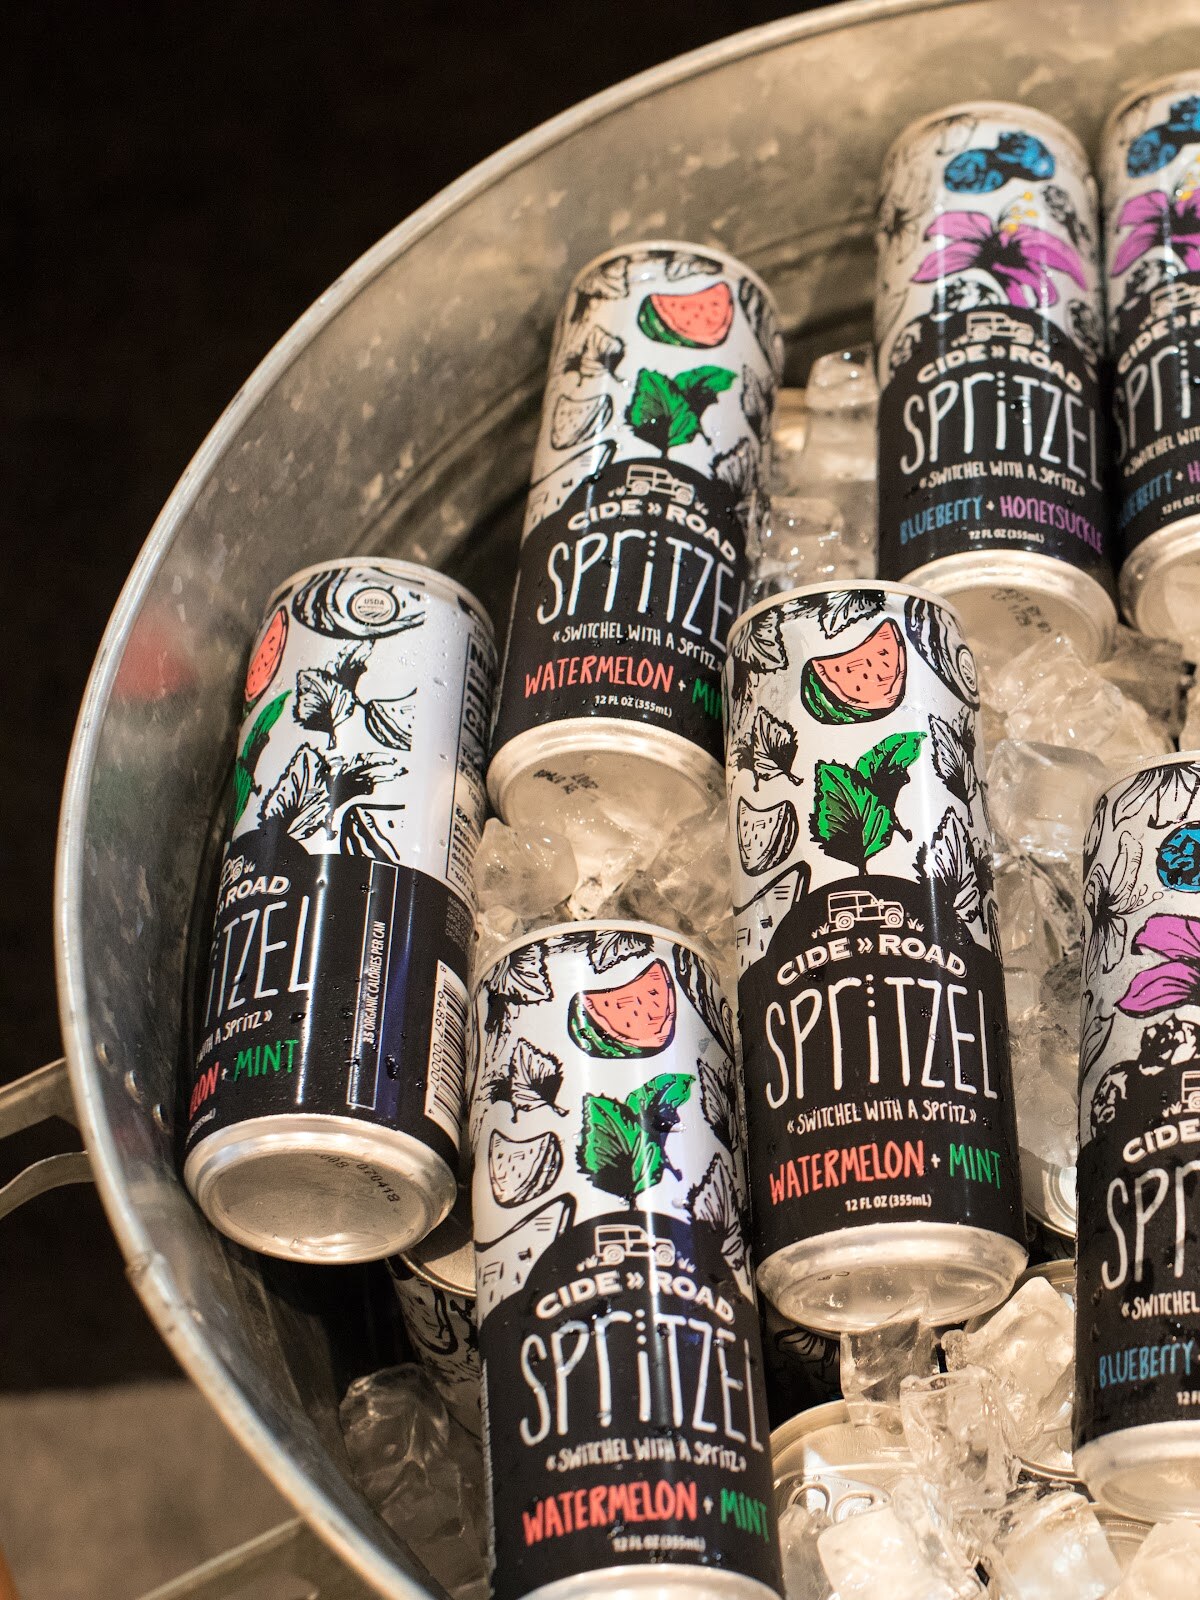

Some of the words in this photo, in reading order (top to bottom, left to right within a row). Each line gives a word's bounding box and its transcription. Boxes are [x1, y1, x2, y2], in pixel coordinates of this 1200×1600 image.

[1118, 320, 1169, 374] CIDE
[917, 344, 988, 383] CIDE
[1010, 345, 1083, 393] ROAD
[928, 461, 986, 488] SWITCHEL
[990, 460, 1024, 479] WITH
[1027, 463, 1037, 479] A
[1162, 504, 1173, 515] 12
[1174, 500, 1183, 510] FL
[1183, 495, 1196, 506] OZ
[567, 499, 643, 531] CIDE
[666, 504, 737, 562] ROAD
[968, 530, 980, 540] 12
[981, 530, 992, 539] FL
[993, 530, 1007, 538] OZ
[364, 598, 385, 606] USDA
[561, 621, 623, 643] SWITCHEL
[628, 624, 662, 643] WITH
[666, 632, 675, 650] A
[524, 655, 674, 699] WATERMELON
[595, 695, 606, 705] 12
[607, 695, 619, 705] FL
[621, 696, 634, 706] OZ
[225, 875, 291, 908] ROAD
[371, 938, 384, 957] PER
[373, 921, 386, 939] CAN
[367, 956, 383, 991] CALORIES
[440, 964, 447, 973] 8
[776, 936, 851, 986] CIDE
[878, 933, 968, 978] ROAD
[364, 990, 379, 1030] ORGANIC
[434, 990, 446, 1038] 64867
[214, 1027, 221, 1045] A
[363, 1030, 375, 1044] 35
[233, 1039, 299, 1082] MINT
[430, 1042, 443, 1092] 00007
[796, 1106, 861, 1135] SWITCHEL
[864, 1099, 902, 1122] WITH
[908, 1099, 919, 1120] A
[1122, 1119, 1200, 1163] CIDE
[357, 1163, 400, 1202] 070418
[768, 1140, 924, 1206] WATERMELON
[950, 1143, 1001, 1189] MINT
[845, 1199, 857, 1212] 12
[858, 1197, 872, 1210] FL
[873, 1196, 888, 1208] OZ
[535, 1270, 623, 1319] CIDE
[652, 1270, 736, 1324] ROAD
[1131, 1290, 1200, 1321] SWITCHEL
[1176, 1392, 1189, 1405] 12
[557, 1437, 633, 1471] SWITCHEL
[632, 1436, 676, 1462] WITH
[679, 1437, 692, 1462] A
[522, 1479, 698, 1547] WATERMELON
[720, 1487, 770, 1544] MINT
